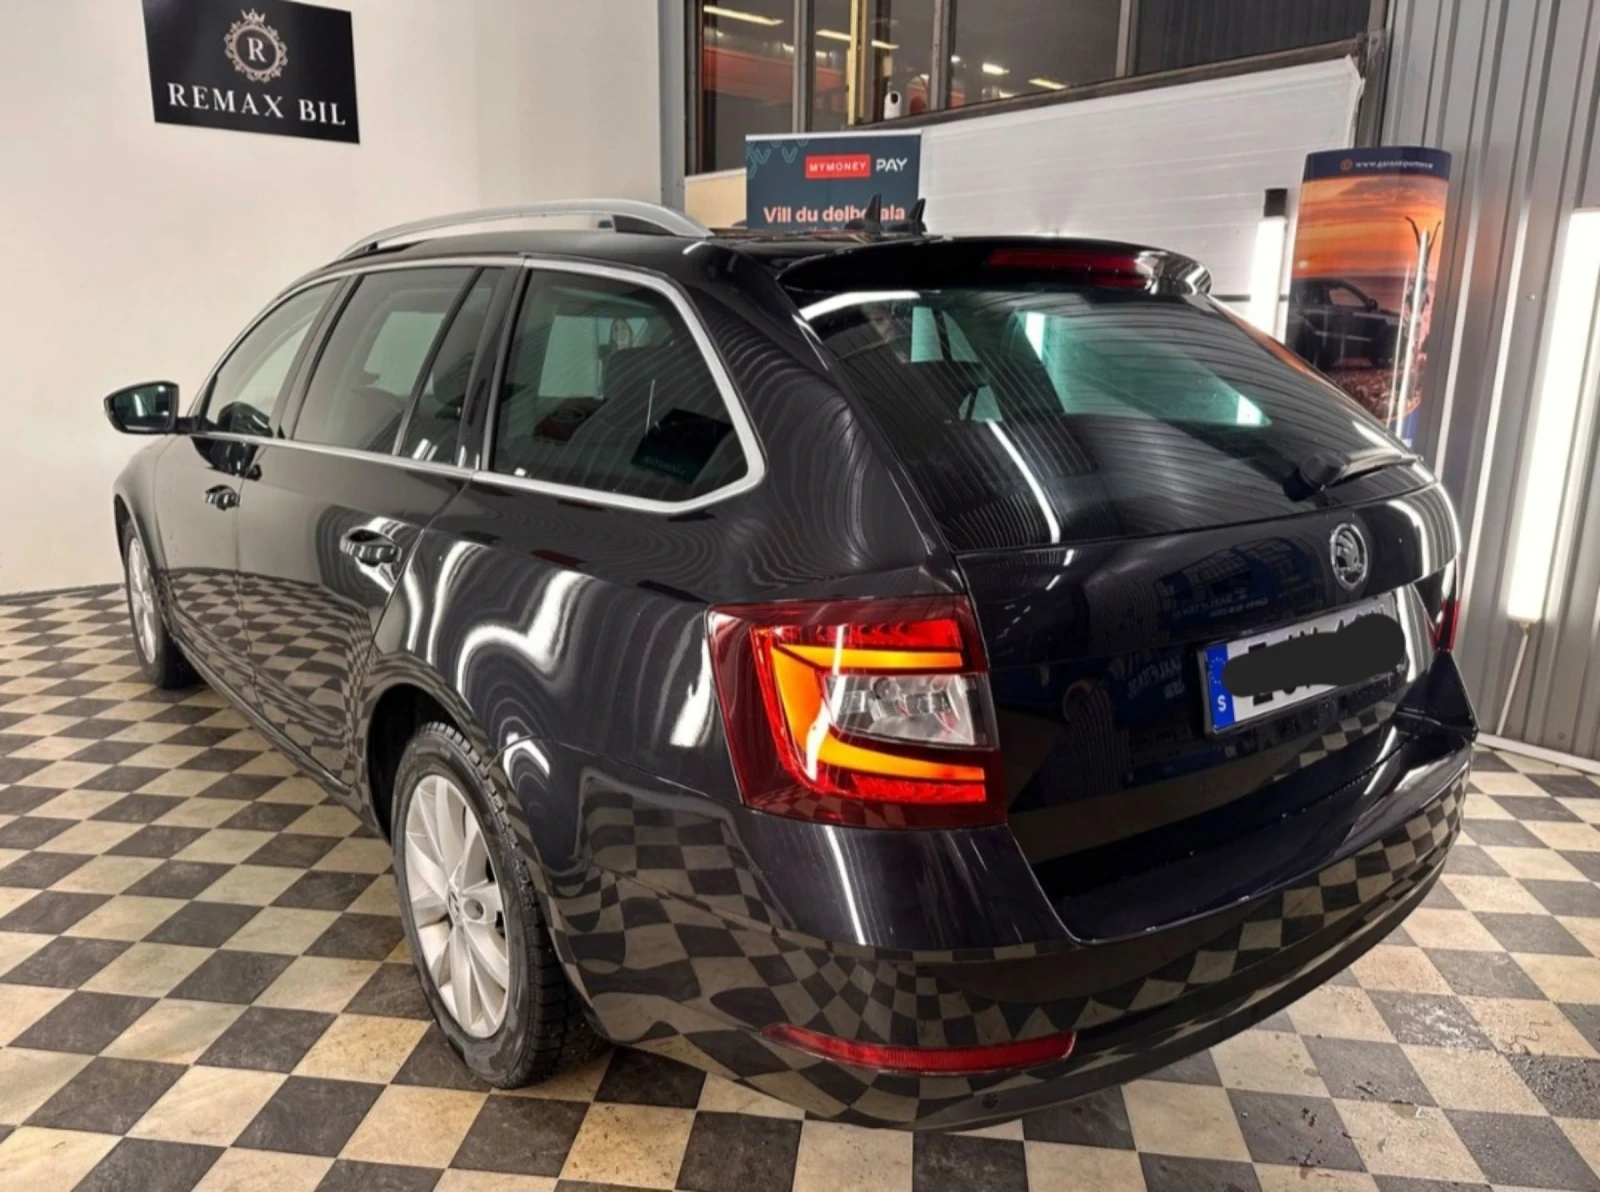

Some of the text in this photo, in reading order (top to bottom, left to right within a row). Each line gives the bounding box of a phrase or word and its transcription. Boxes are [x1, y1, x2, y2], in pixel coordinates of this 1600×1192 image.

[246, 36, 267, 63] R
[167, 82, 346, 126] REMAX BIL
[809, 157, 908, 173] MYMONEY PAY
[763, 204, 906, 223] Vill du delbala
[1217, 694, 1227, 712] S
